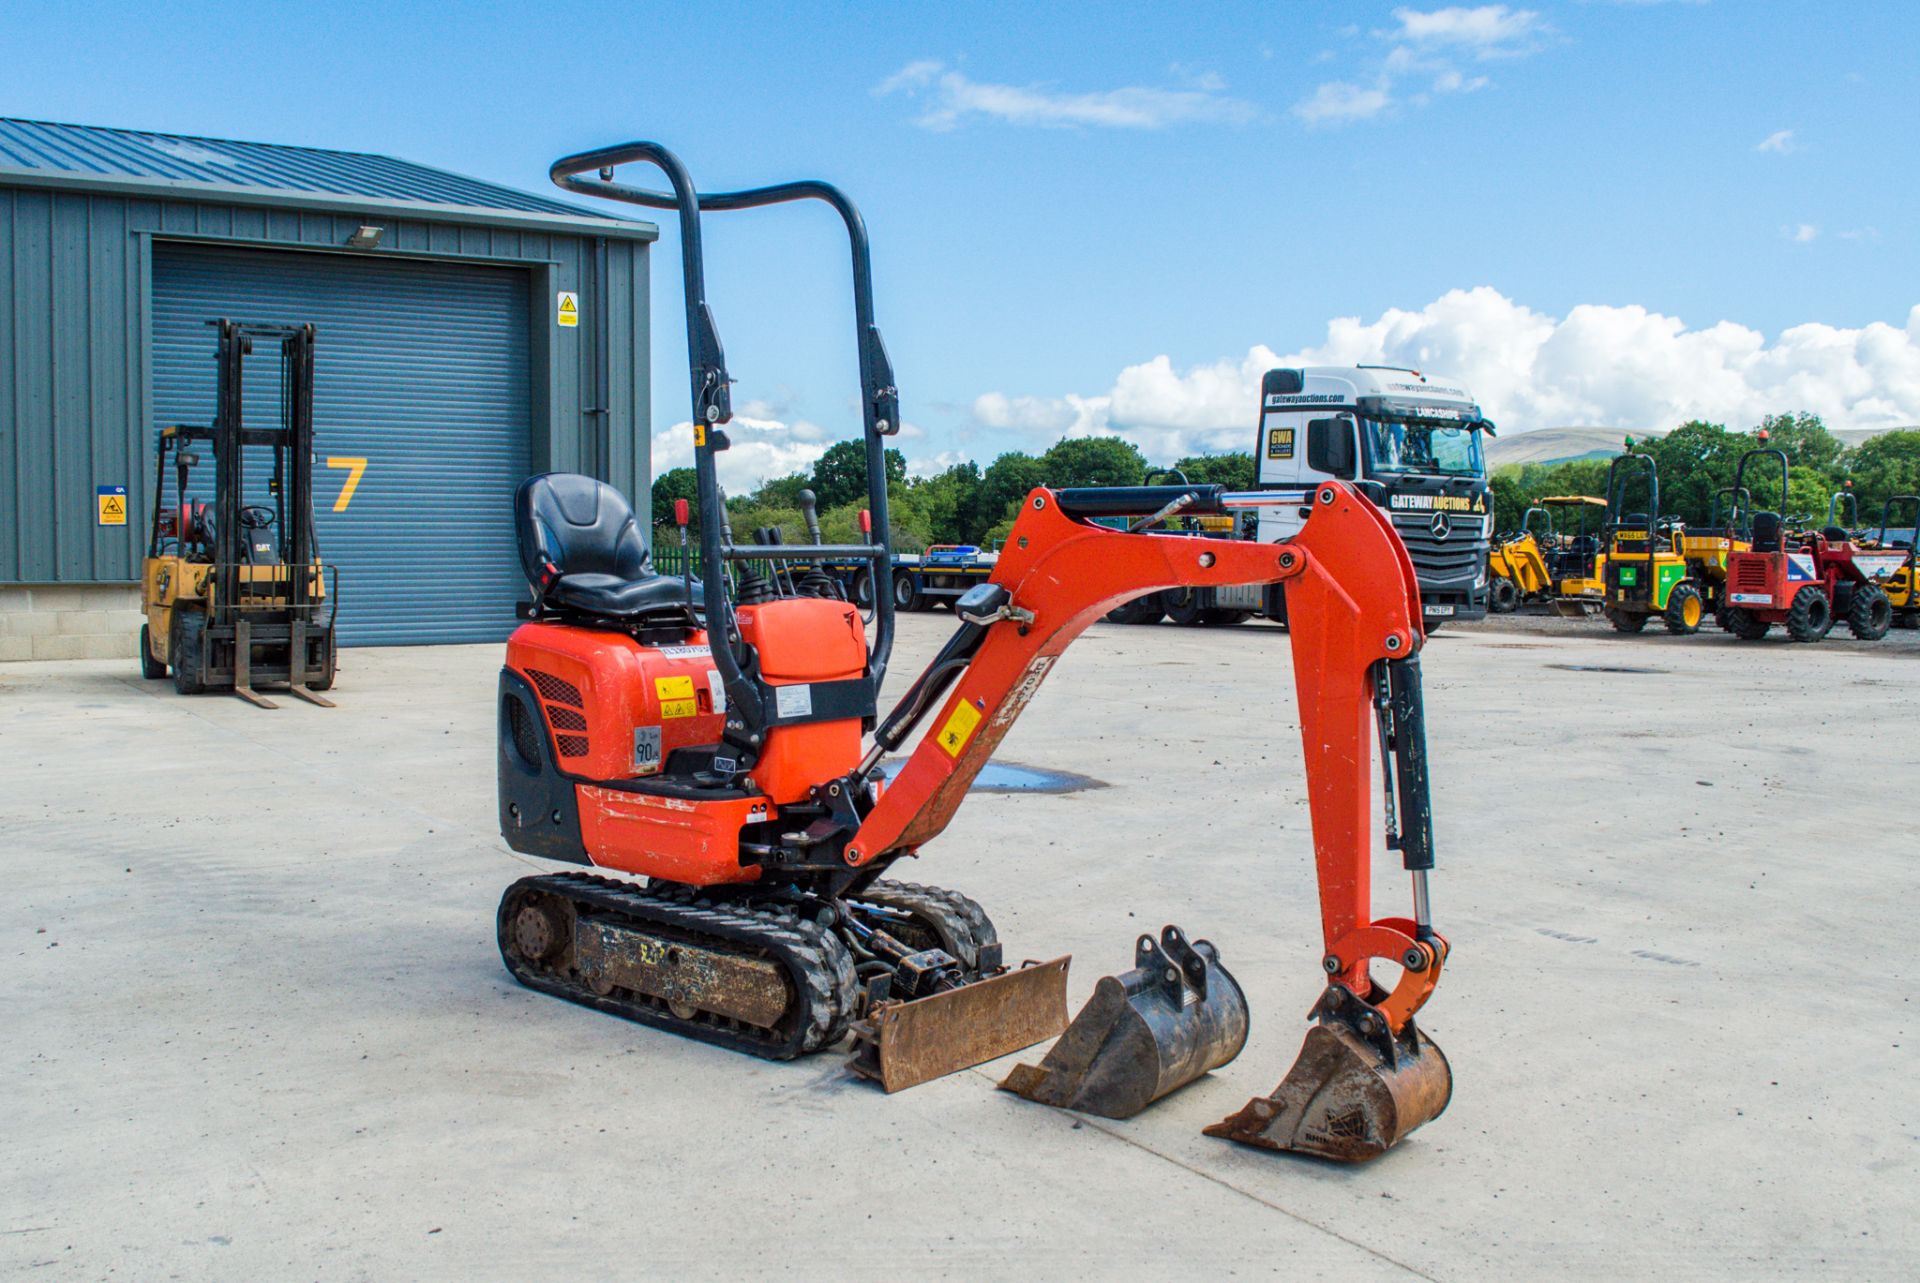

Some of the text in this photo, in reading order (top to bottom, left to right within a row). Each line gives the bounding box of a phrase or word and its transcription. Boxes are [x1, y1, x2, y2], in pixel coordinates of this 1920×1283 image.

[1272, 394, 1345, 405] gatewayauctions.com
[1271, 430, 1292, 444] GWA
[326, 456, 368, 512] 7
[636, 743, 652, 762] 90
